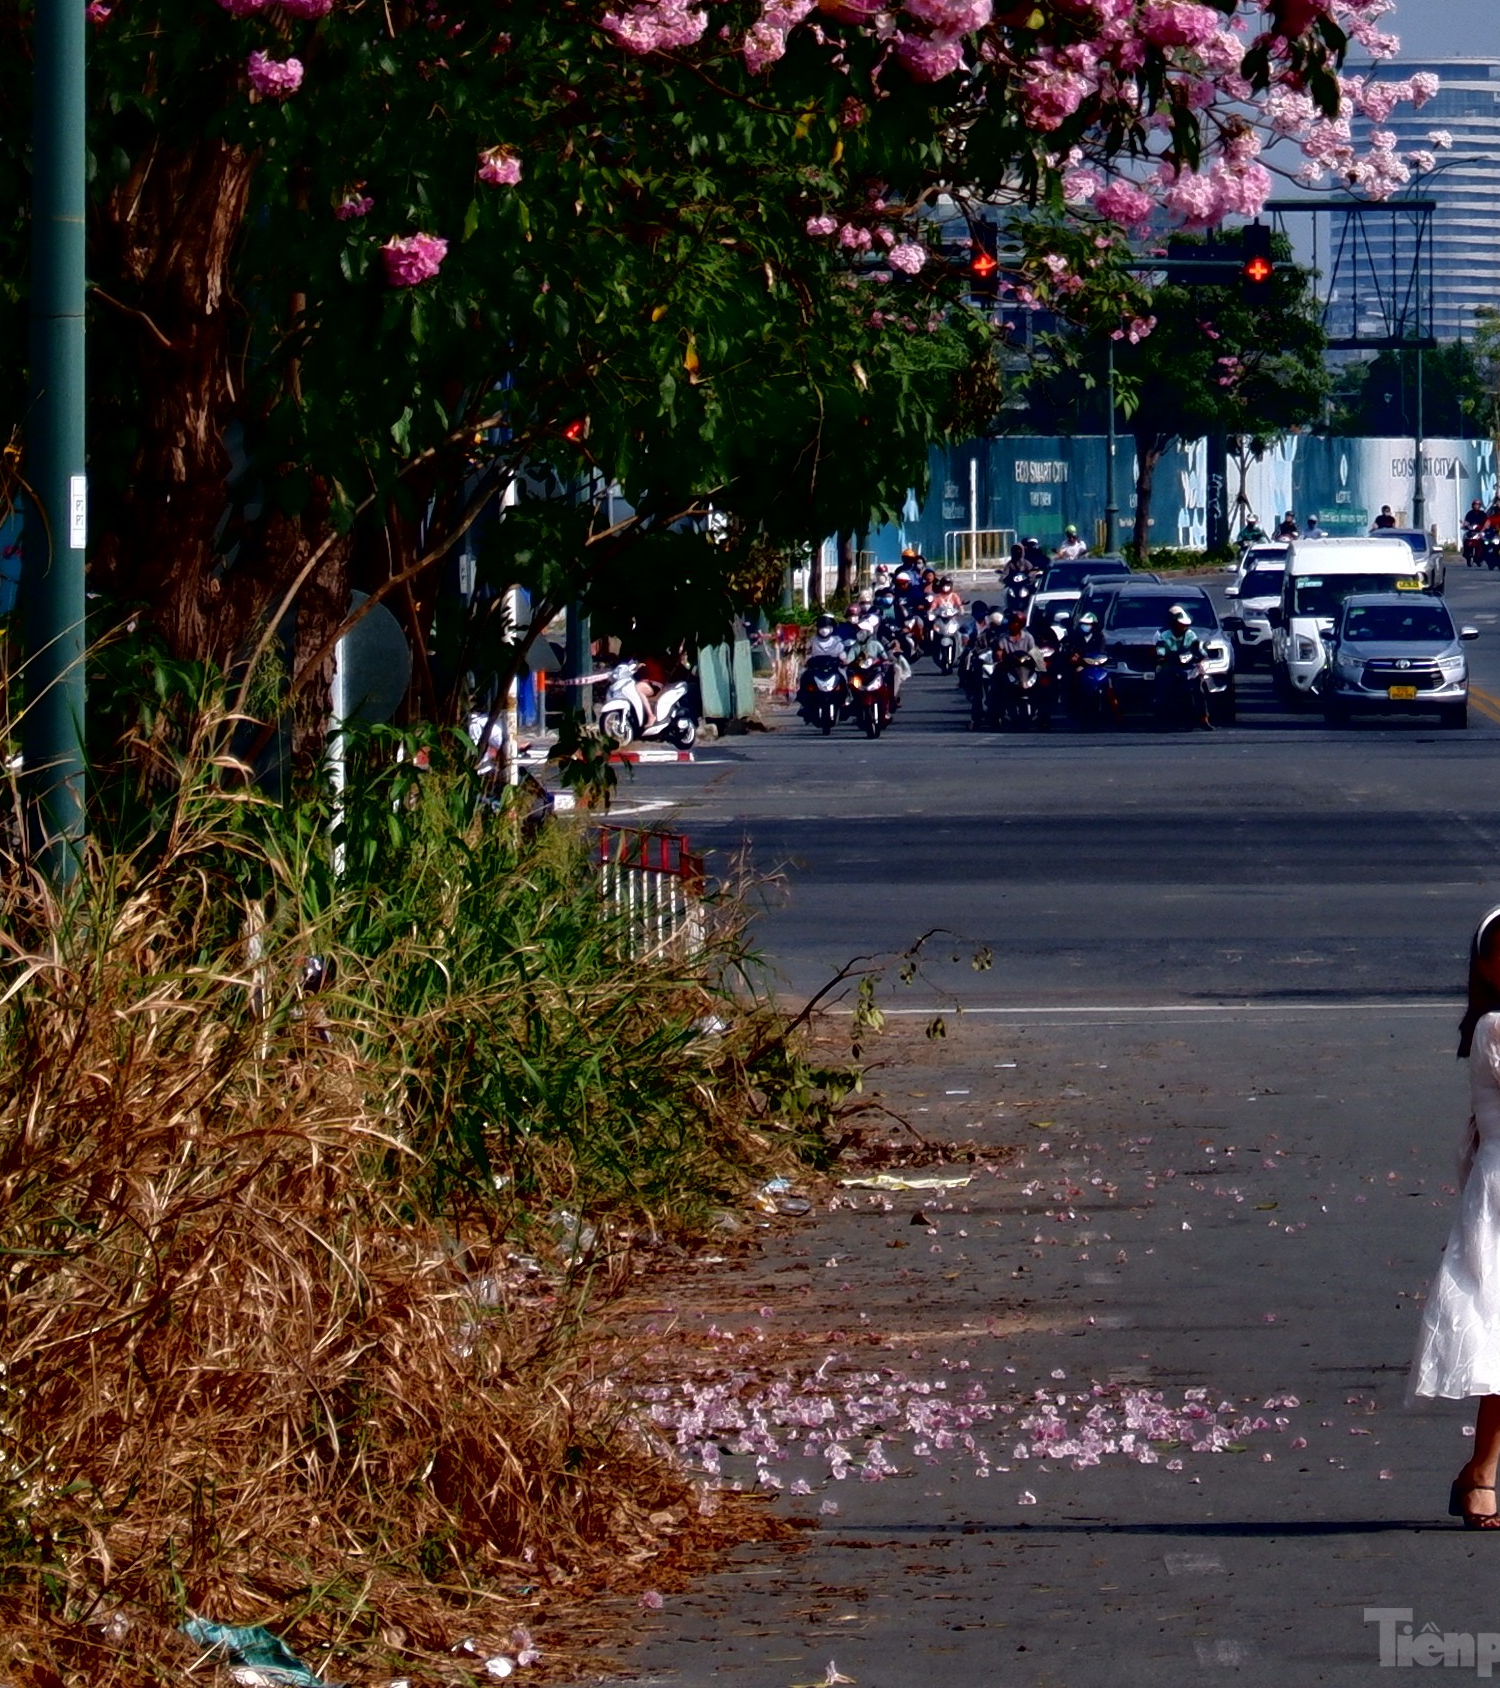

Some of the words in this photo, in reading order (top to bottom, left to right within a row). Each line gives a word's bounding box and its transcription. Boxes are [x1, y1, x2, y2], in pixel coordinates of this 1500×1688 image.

[1015, 460, 1029, 483] ECO
[1052, 461, 1069, 483] CITY
[1391, 458, 1407, 478] ECO
